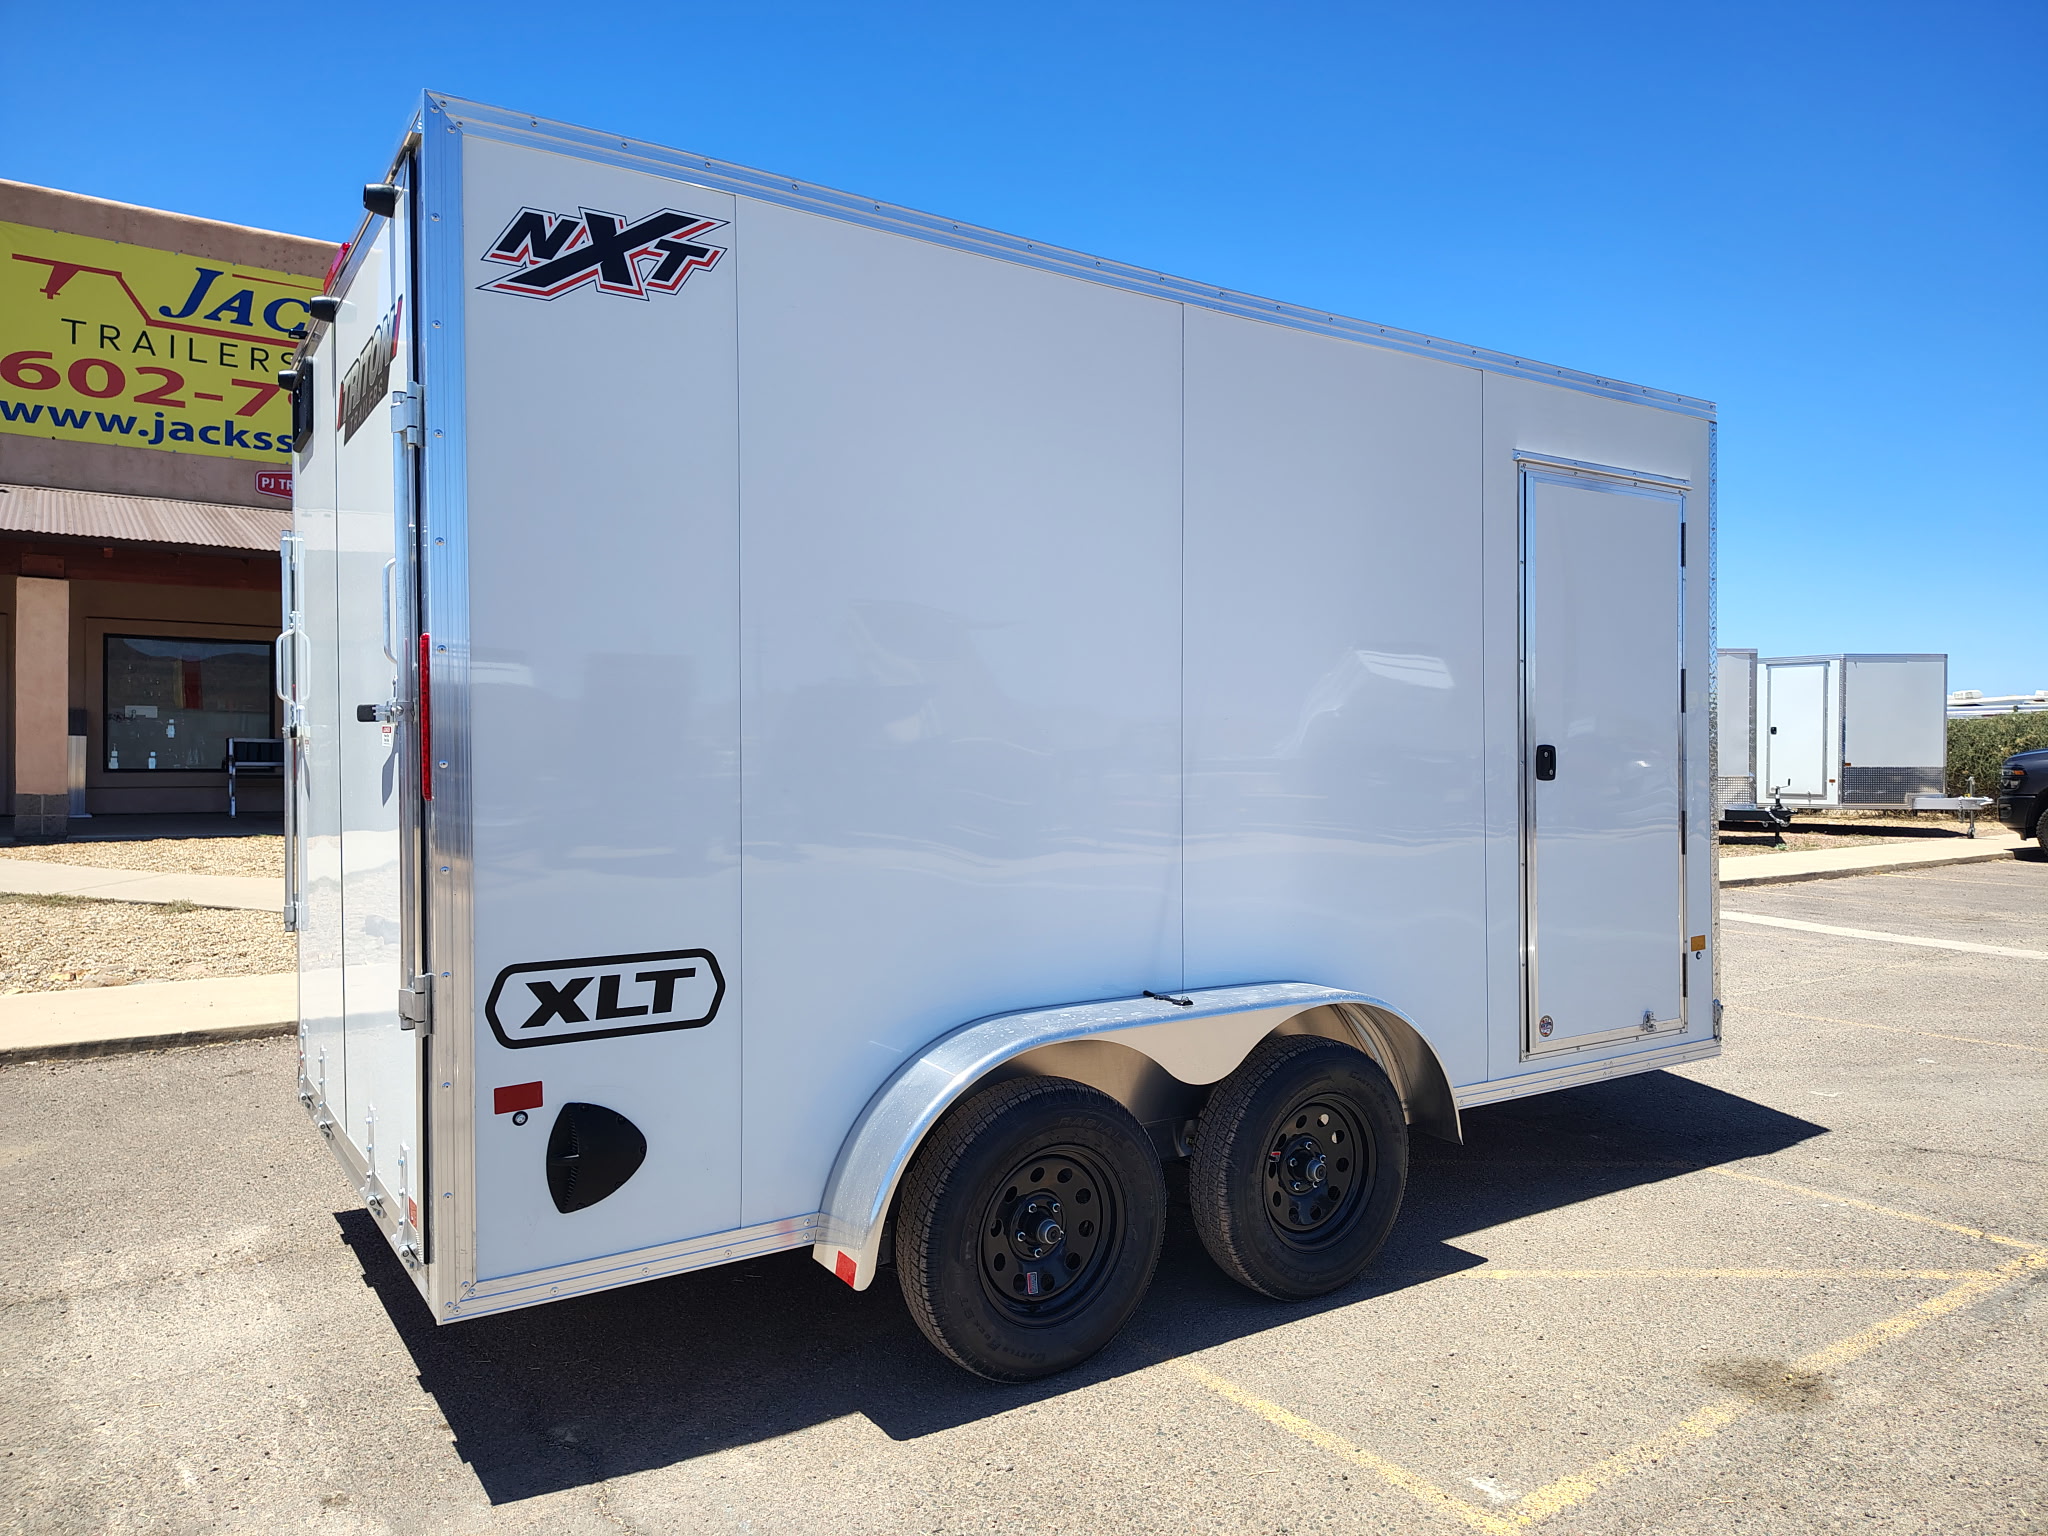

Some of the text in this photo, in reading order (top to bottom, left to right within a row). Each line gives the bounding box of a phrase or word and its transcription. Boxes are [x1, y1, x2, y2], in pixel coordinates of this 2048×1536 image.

[487, 209, 721, 297] NXT
[0, 350, 292, 417] 602-7
[342, 303, 398, 423] TRITON
[261, 477, 275, 489] PJ
[519, 967, 697, 1030] XLT
